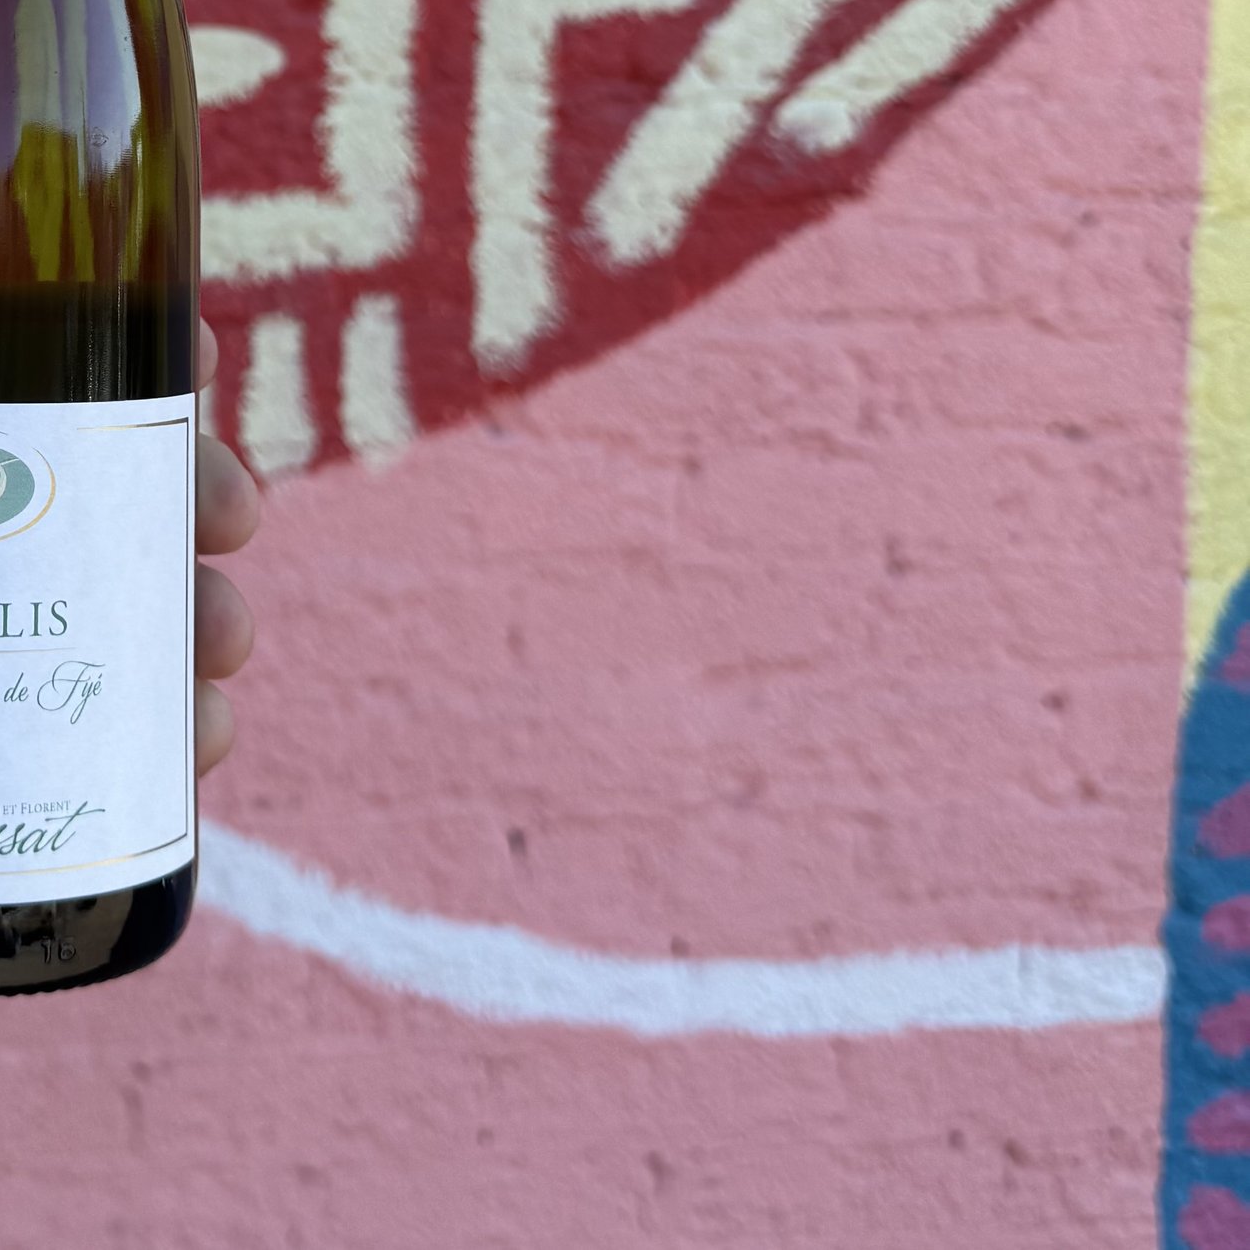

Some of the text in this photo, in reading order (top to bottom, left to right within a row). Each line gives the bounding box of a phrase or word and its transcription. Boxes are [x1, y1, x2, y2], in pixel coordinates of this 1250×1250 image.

[3, 671, 30, 703] de
[36, 659, 107, 725] Fyé
[2, 804, 18, 816] ET
[19, 799, 72, 815] FLORENT
